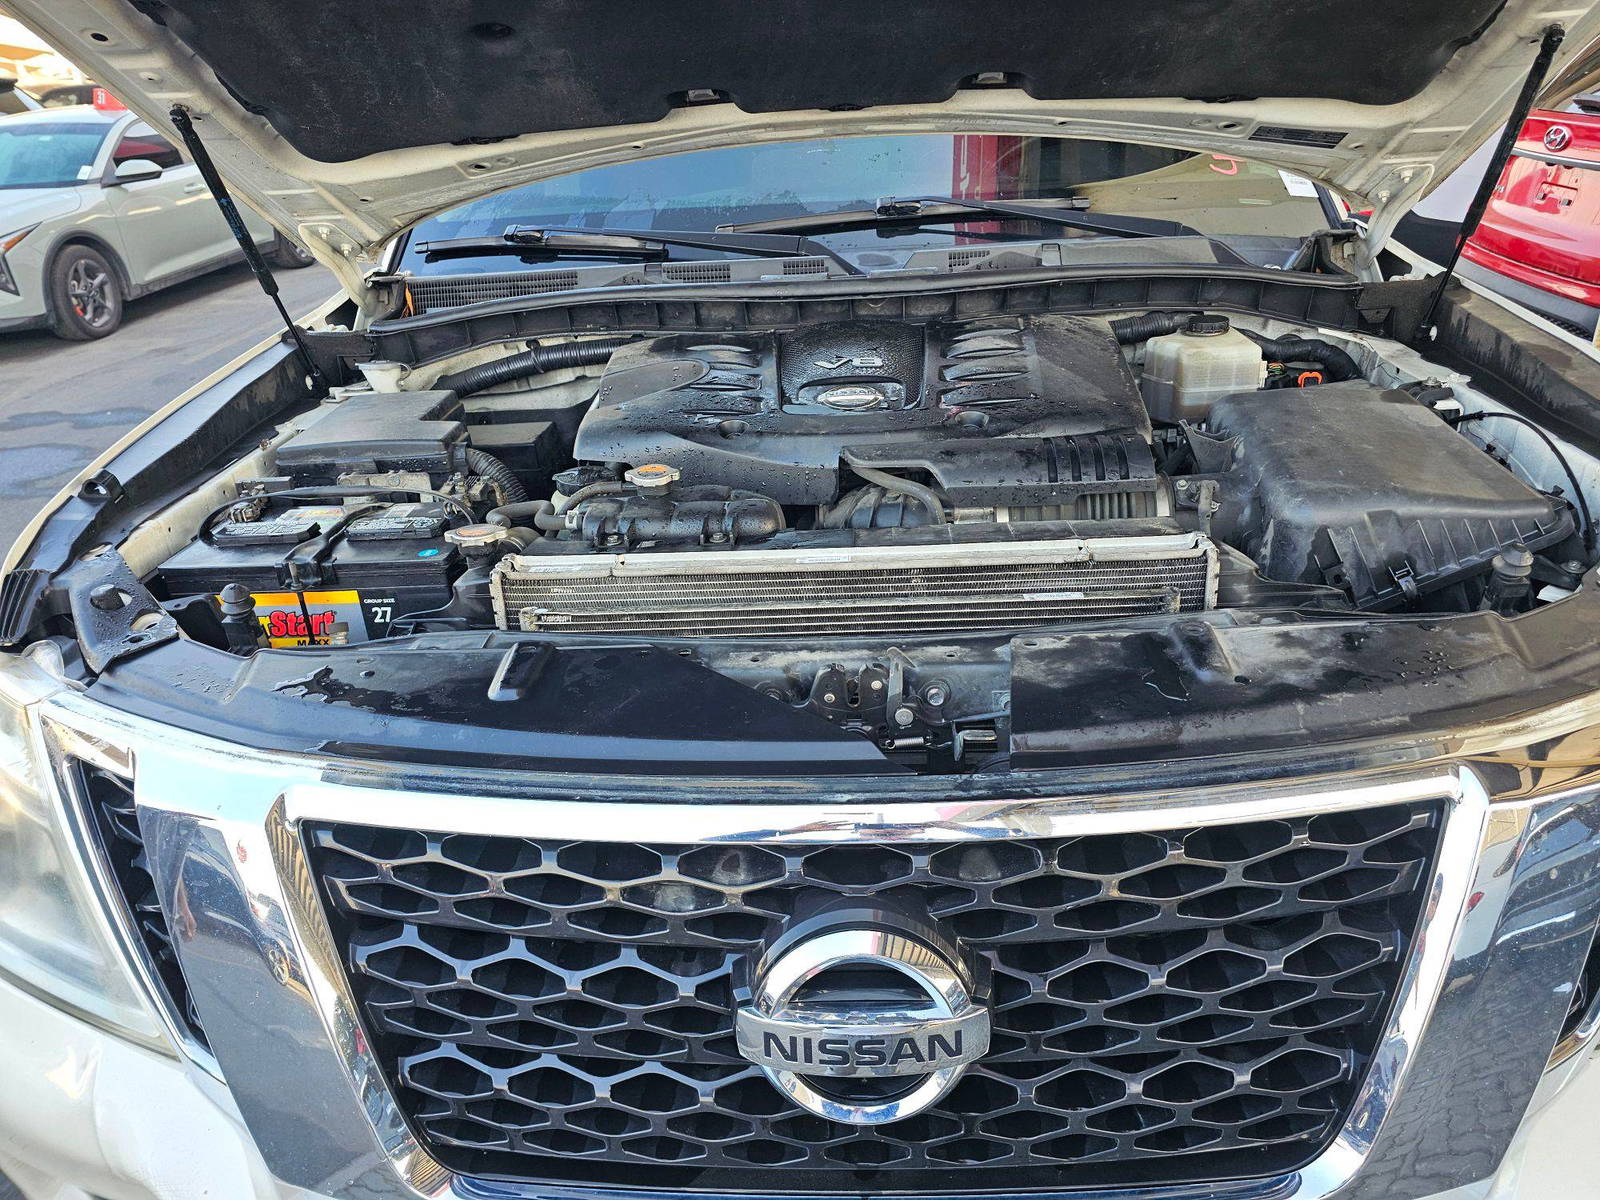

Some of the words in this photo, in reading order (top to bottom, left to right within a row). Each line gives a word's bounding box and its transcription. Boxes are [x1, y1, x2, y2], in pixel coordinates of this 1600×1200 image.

[371, 606, 392, 623] 27
[297, 639, 330, 647] MXX
[763, 1030, 963, 1067] NISSAN
